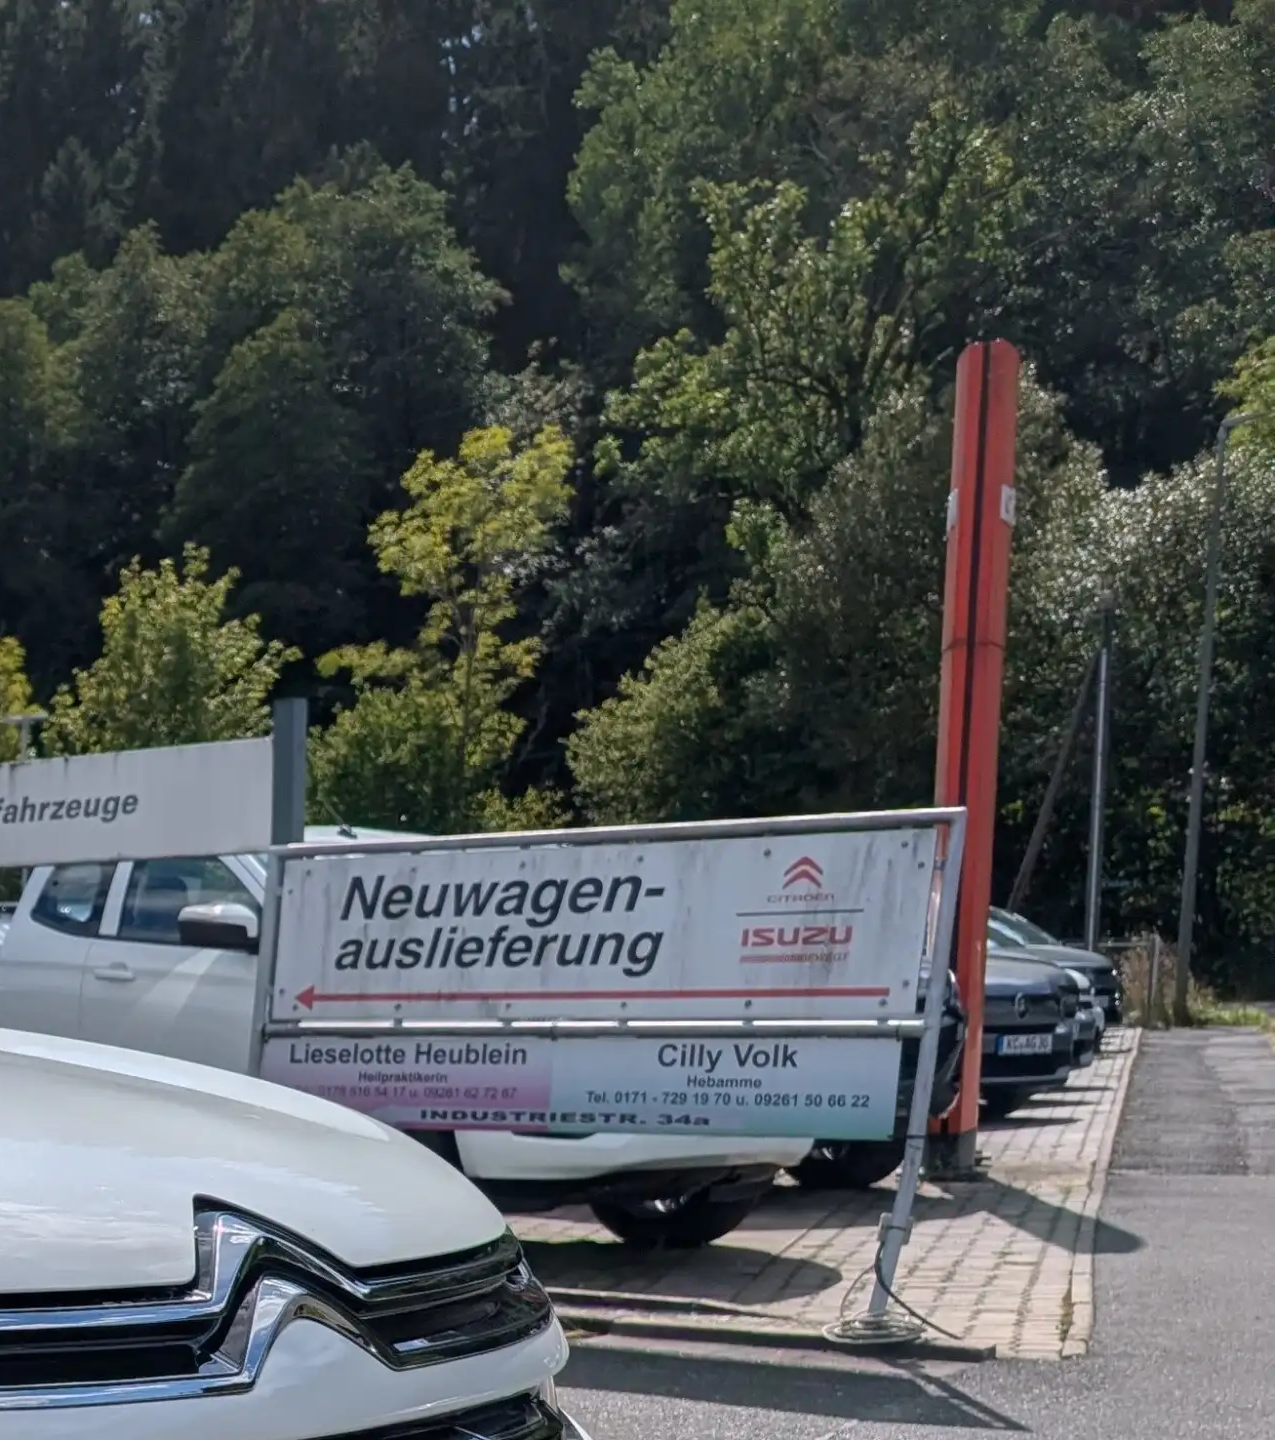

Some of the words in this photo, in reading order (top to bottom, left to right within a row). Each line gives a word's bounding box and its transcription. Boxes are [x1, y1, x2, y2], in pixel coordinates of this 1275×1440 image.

[339, 874, 666, 928] Neuwagen-
[741, 925, 853, 947] ISUZU
[334, 925, 665, 978] auslieferung
[289, 1043, 406, 1066] Lieselotte
[414, 1043, 528, 1066] Heublein
[657, 1043, 723, 1073] Cilly
[733, 1043, 798, 1068] Volk
[358, 1070, 449, 1084] Heilpraktikerin
[686, 1074, 762, 1089] Hebamme
[586, 1090, 610, 1104] Tel.
[614, 1091, 647, 1105] 0171
[662, 1092, 688, 1106] 729
[714, 1093, 731, 1106] 70
[754, 1093, 798, 1107] 09261
[804, 1093, 823, 1108] 50
[851, 1094, 870, 1108] 22
[420, 1109, 647, 1125] INDUSTRIESTR.
[657, 1113, 710, 1126] 34a
